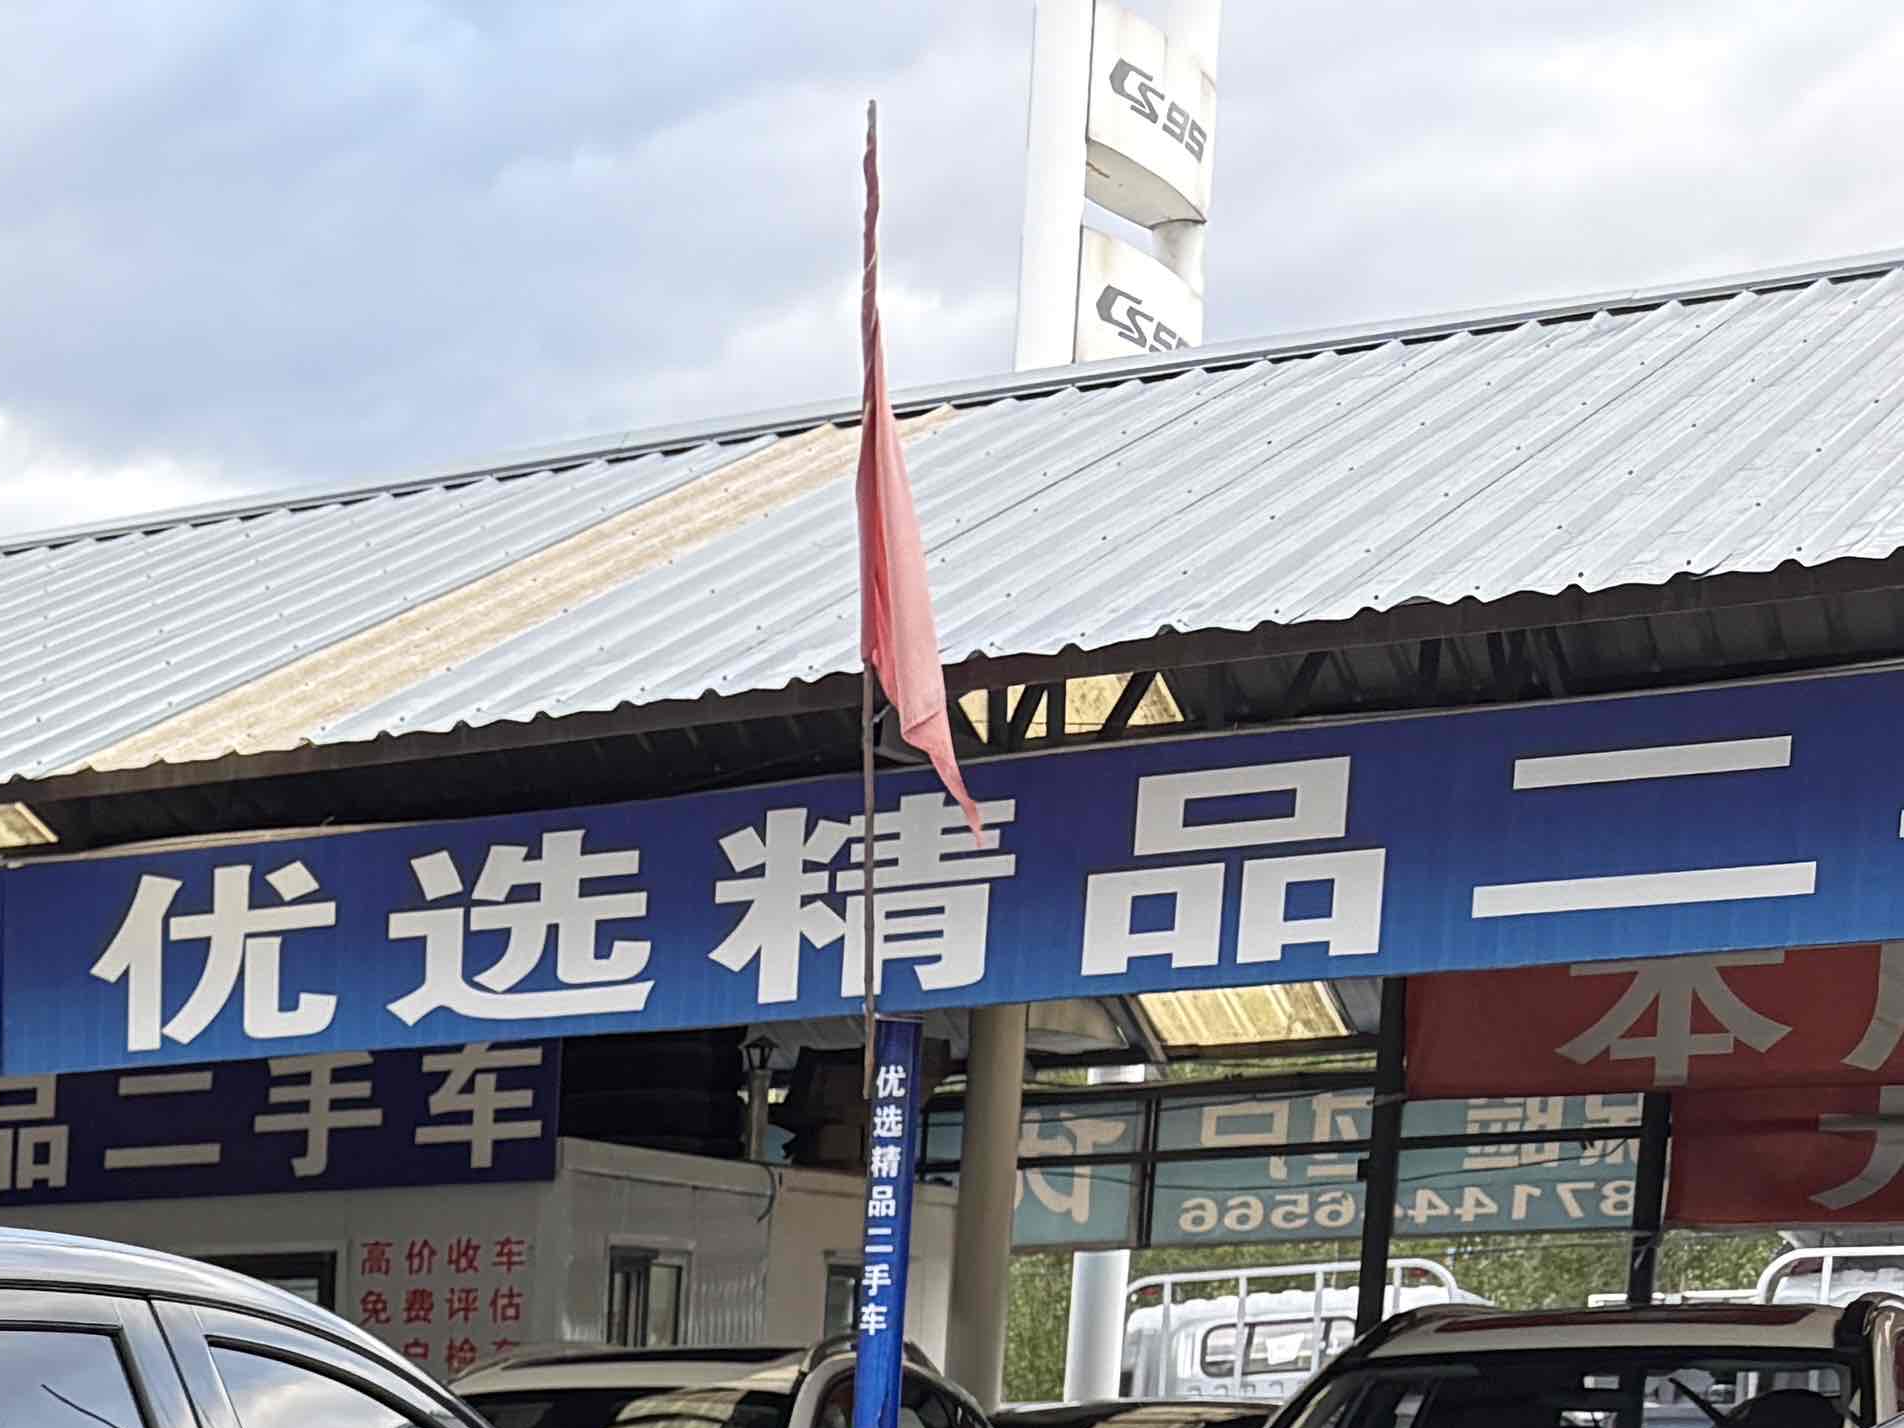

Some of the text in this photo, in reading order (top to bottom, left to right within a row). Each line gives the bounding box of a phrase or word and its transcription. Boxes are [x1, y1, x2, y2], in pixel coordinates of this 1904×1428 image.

[90, 735, 1904, 1052] 优选精品二
[360, 1236, 527, 1276] 高价收车
[859, 1064, 907, 1337] 优选精品二手车
[359, 1285, 524, 1325] 免费评估
